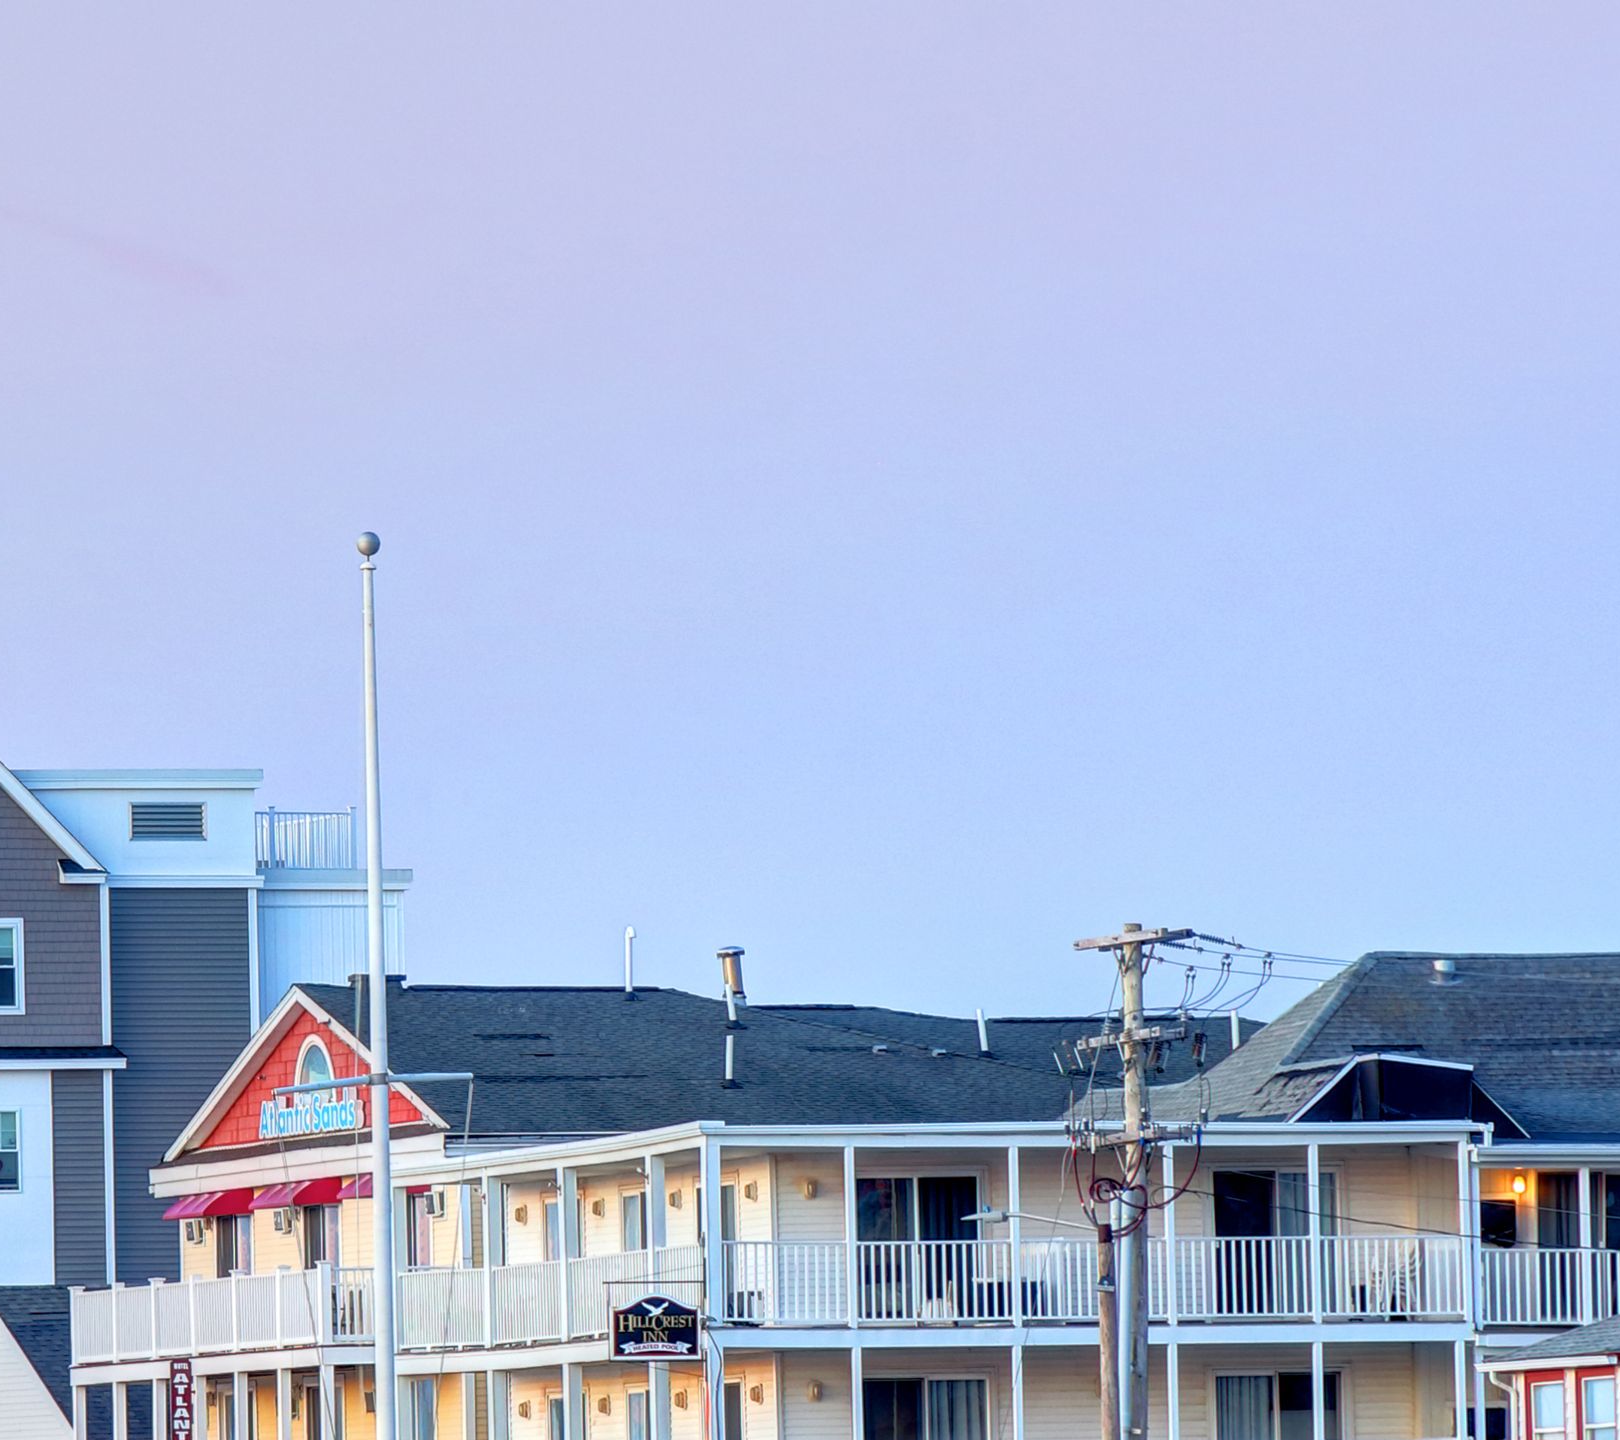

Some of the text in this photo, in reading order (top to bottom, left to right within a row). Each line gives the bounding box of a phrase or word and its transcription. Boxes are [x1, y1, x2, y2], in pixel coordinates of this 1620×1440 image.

[258, 1086, 356, 1139] Atlantic Sands
[618, 1314, 694, 1332] HILLCREST
[642, 1331, 669, 1342] INN
